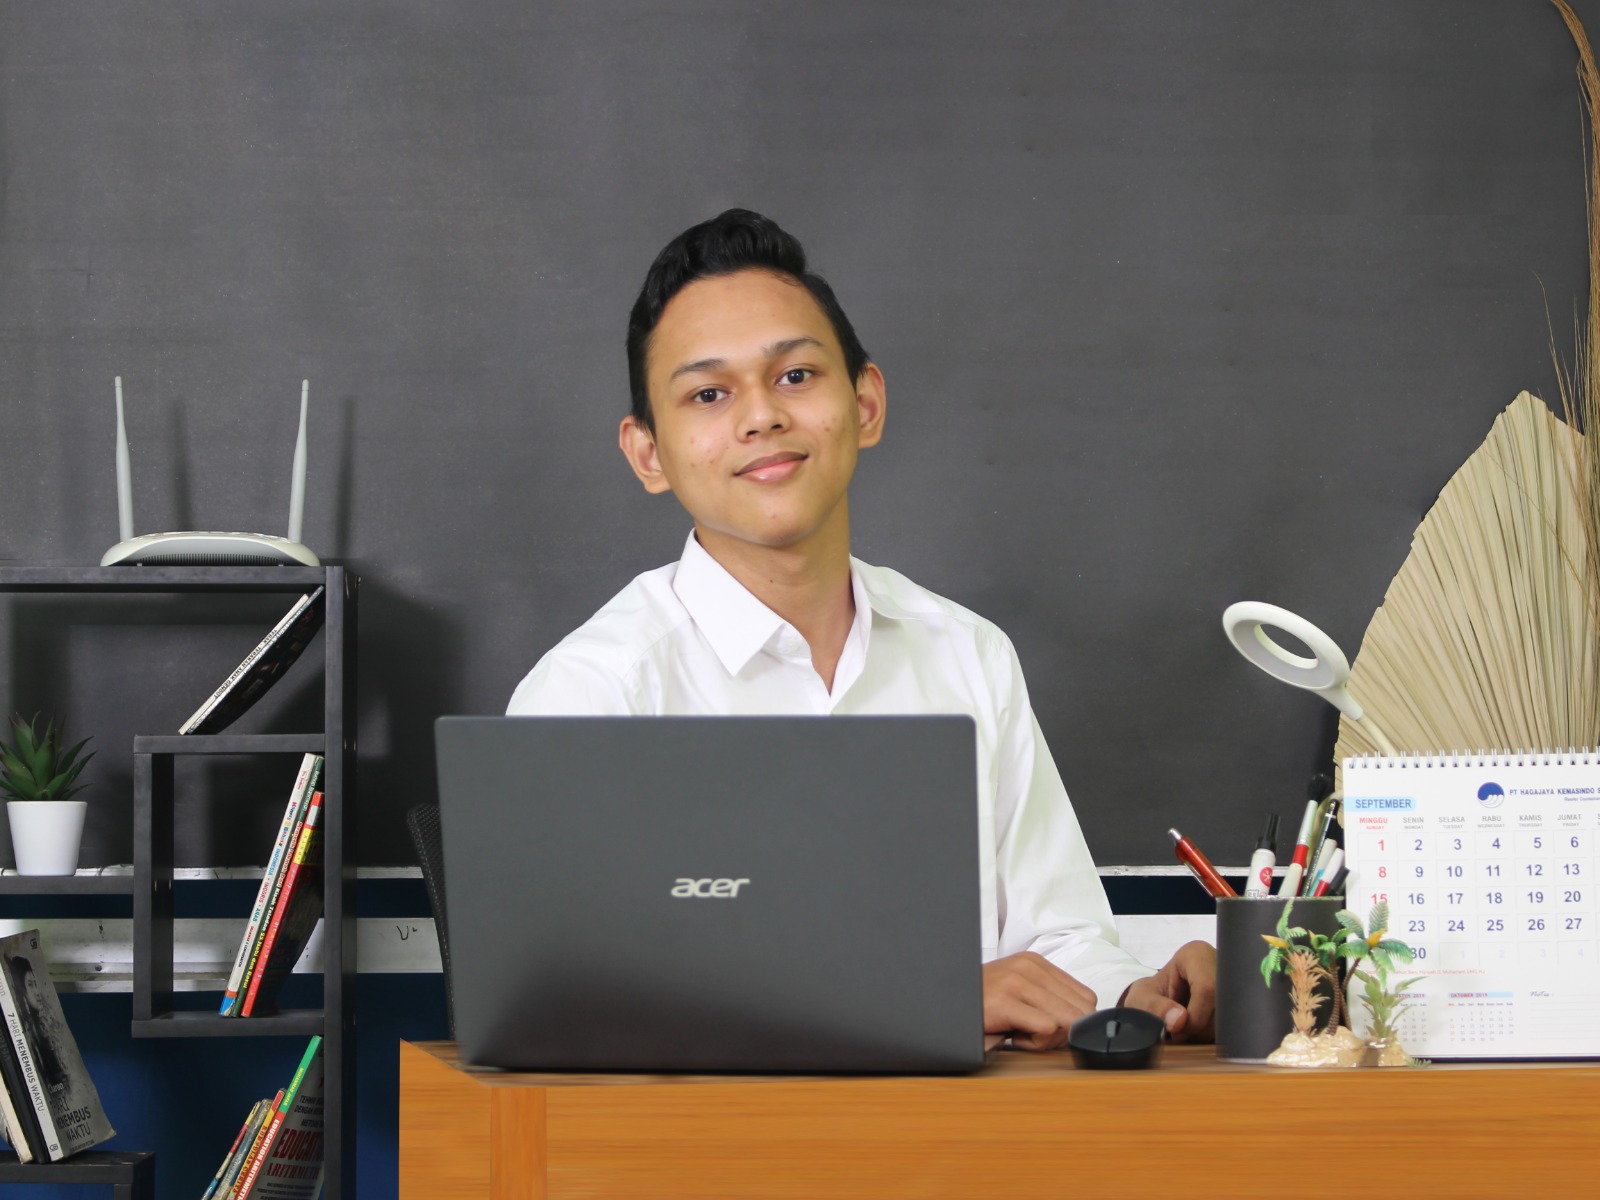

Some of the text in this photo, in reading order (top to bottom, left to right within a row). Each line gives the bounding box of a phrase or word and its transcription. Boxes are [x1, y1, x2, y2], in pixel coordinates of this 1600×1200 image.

[1356, 799, 1411, 808] SEPTEMBER
[1379, 836, 1579, 851] 1 2 3 4 5 6
[268, 848, 281, 876] INDONESIA
[1379, 863, 1580, 878] 8 9 10 11 12 13
[259, 882, 270, 903] INGGRIS
[665, 872, 756, 904] acer
[271, 888, 280, 906] Kisah
[1372, 891, 1581, 904] 15 16 17 18 19 20
[253, 908, 261, 922] ARAB
[262, 907, 274, 931] Teladan
[1409, 918, 1582, 932] 23 24 25 26 27
[260, 932, 265, 940] 25
[254, 941, 262, 957] Nabi
[1411, 948, 1426, 959] 30
[243, 971, 252, 988] Rasul
[10, 1019, 20, 1037] HARI
[16, 1039, 35, 1083] MENEMBUS
[31, 1085, 44, 1112] WAKTU
[57, 1106, 91, 1129] MENEMBUS
[66, 1121, 91, 1142] WAKTU
[238, 1119, 279, 1200] EDUCATION ARITHMETI
